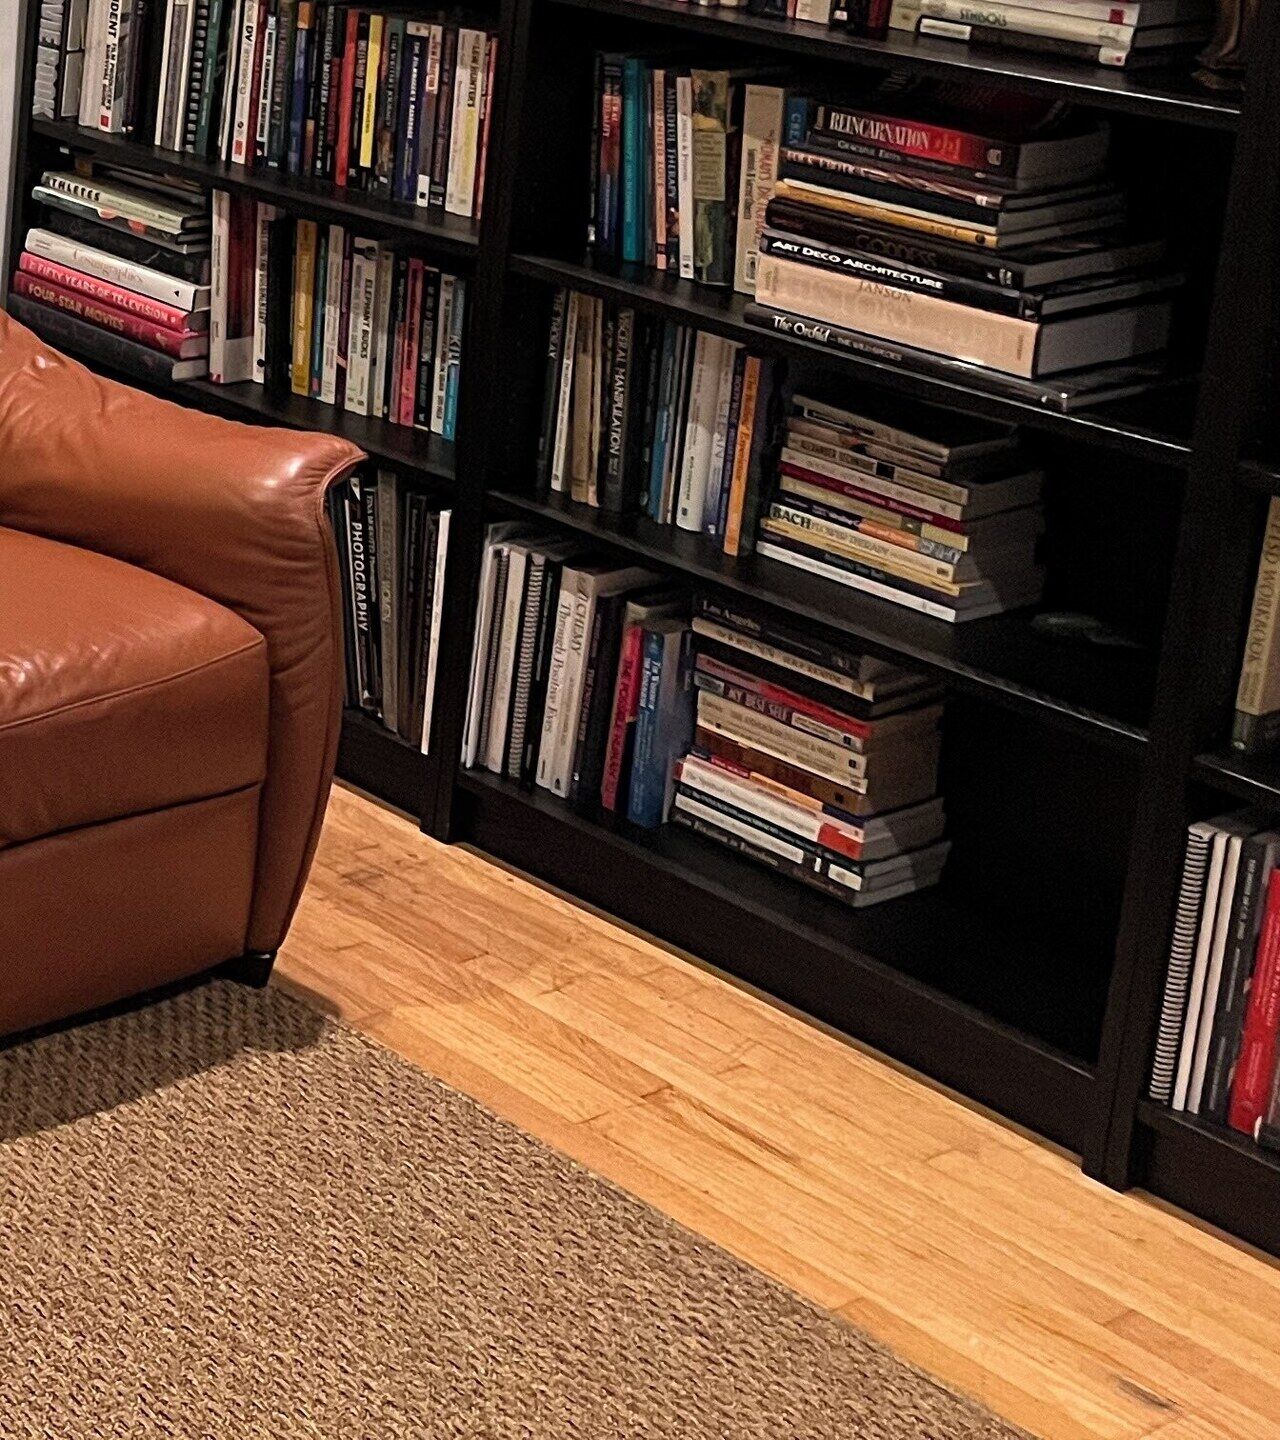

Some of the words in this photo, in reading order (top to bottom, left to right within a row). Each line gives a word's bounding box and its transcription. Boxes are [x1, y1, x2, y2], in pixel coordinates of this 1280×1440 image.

[245, 25, 254, 42] DV
[324, 6, 335, 60] WATCHING
[32, 46, 61, 120] BOOK
[321, 63, 331, 103] MOVIES
[467, 65, 480, 108] HUNTER'S
[666, 88, 676, 143] MINDFUL
[830, 111, 930, 150] REINCARNATION
[666, 148, 676, 198] THERAPY
[772, 240, 800, 254] ART
[802, 247, 840, 263] DECO
[843, 259, 944, 290] ARCHITECTURE
[28, 282, 83, 313] FOUR-STAR
[84, 304, 125, 331] MOVIES
[38, 263, 66, 281] FIFTY
[66, 273, 95, 294] YEARS
[98, 283, 110, 298] OF
[111, 291, 168, 323] TELEVISION
[362, 279, 374, 327] ELEPHANT
[857, 280, 912, 303] JANSON
[360, 329, 370, 359] BUCKS
[616, 312, 630, 363] VISCERAL
[772, 315, 792, 332] The
[609, 367, 627, 455] MANIPULATION
[771, 504, 811, 530] BACH
[351, 522, 368, 631] PHOTOGRAPHY
[555, 603, 571, 655] Through
[571, 591, 588, 655] ALCHEMY
[1247, 568, 1276, 664] WORKBOOK
[608, 735, 624, 777] HUMAN
